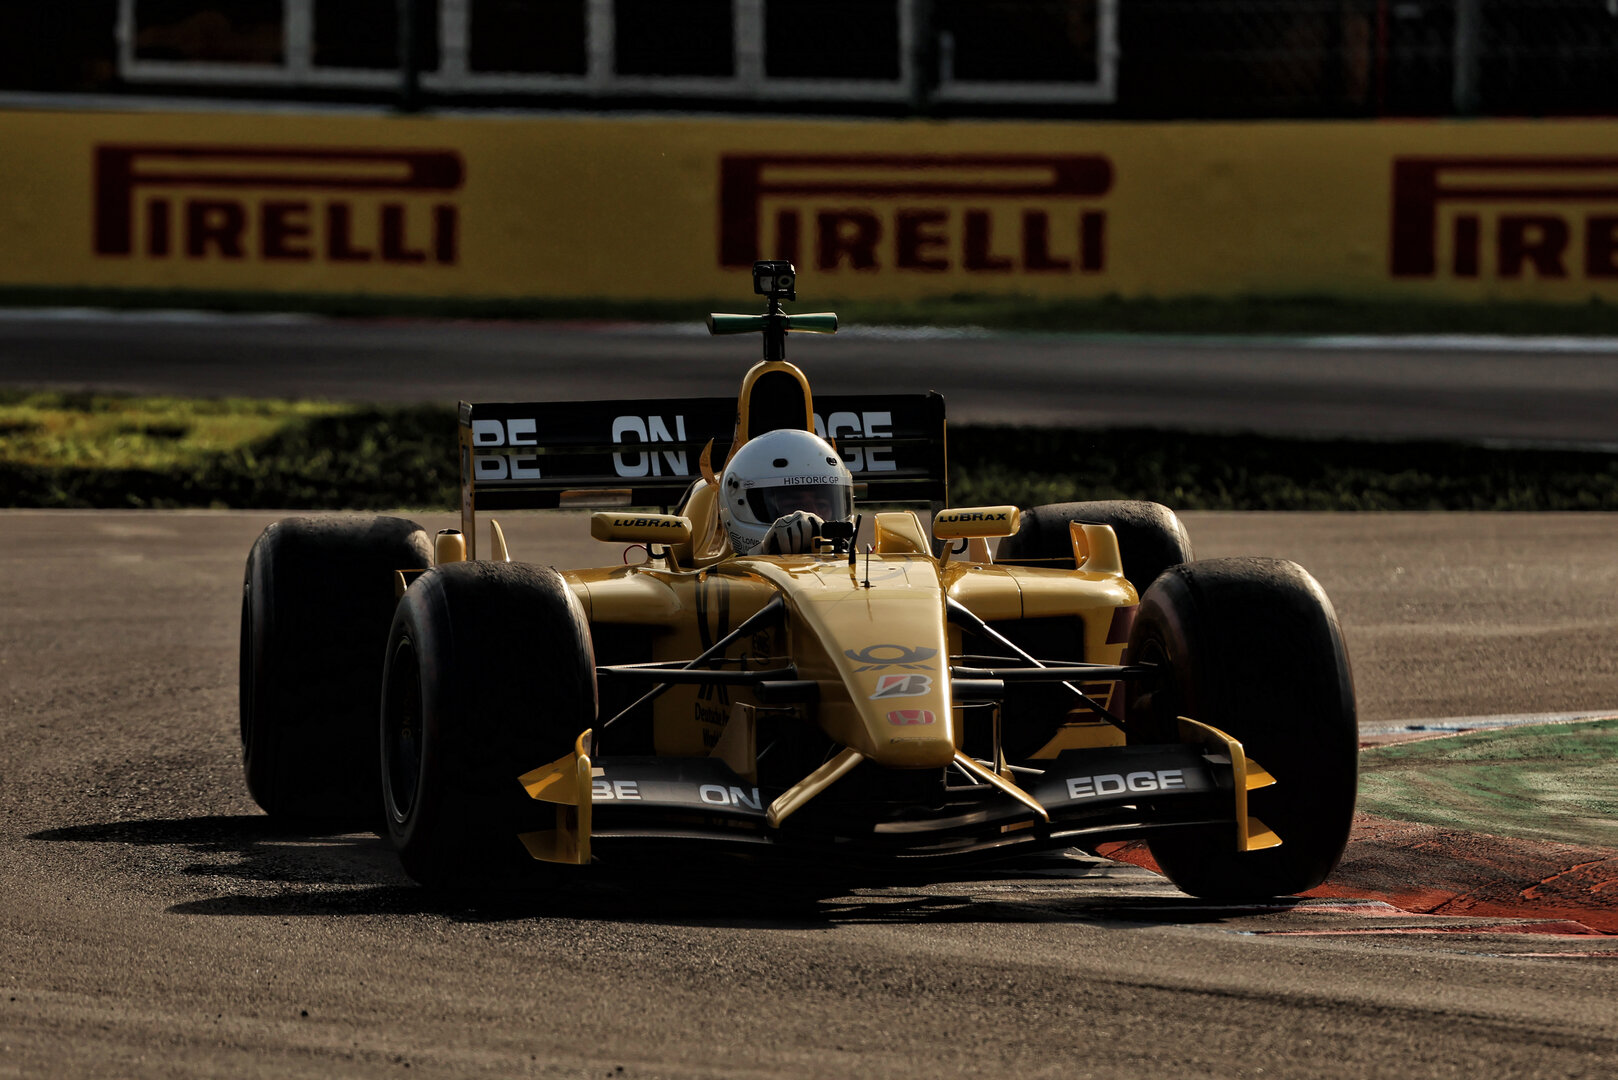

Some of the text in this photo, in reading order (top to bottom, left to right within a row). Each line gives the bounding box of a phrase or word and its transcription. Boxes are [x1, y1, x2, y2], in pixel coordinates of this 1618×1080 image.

[95, 146, 466, 264] PIRELLI
[719, 154, 1114, 272] PIRELLI
[472, 411, 896, 480] BE ON GE
[783, 477, 827, 485] HISTORIC
[613, 519, 683, 528] LUBRAX
[939, 513, 1007, 523] LUBRAX
[592, 769, 1186, 810] BE ON EDGE
